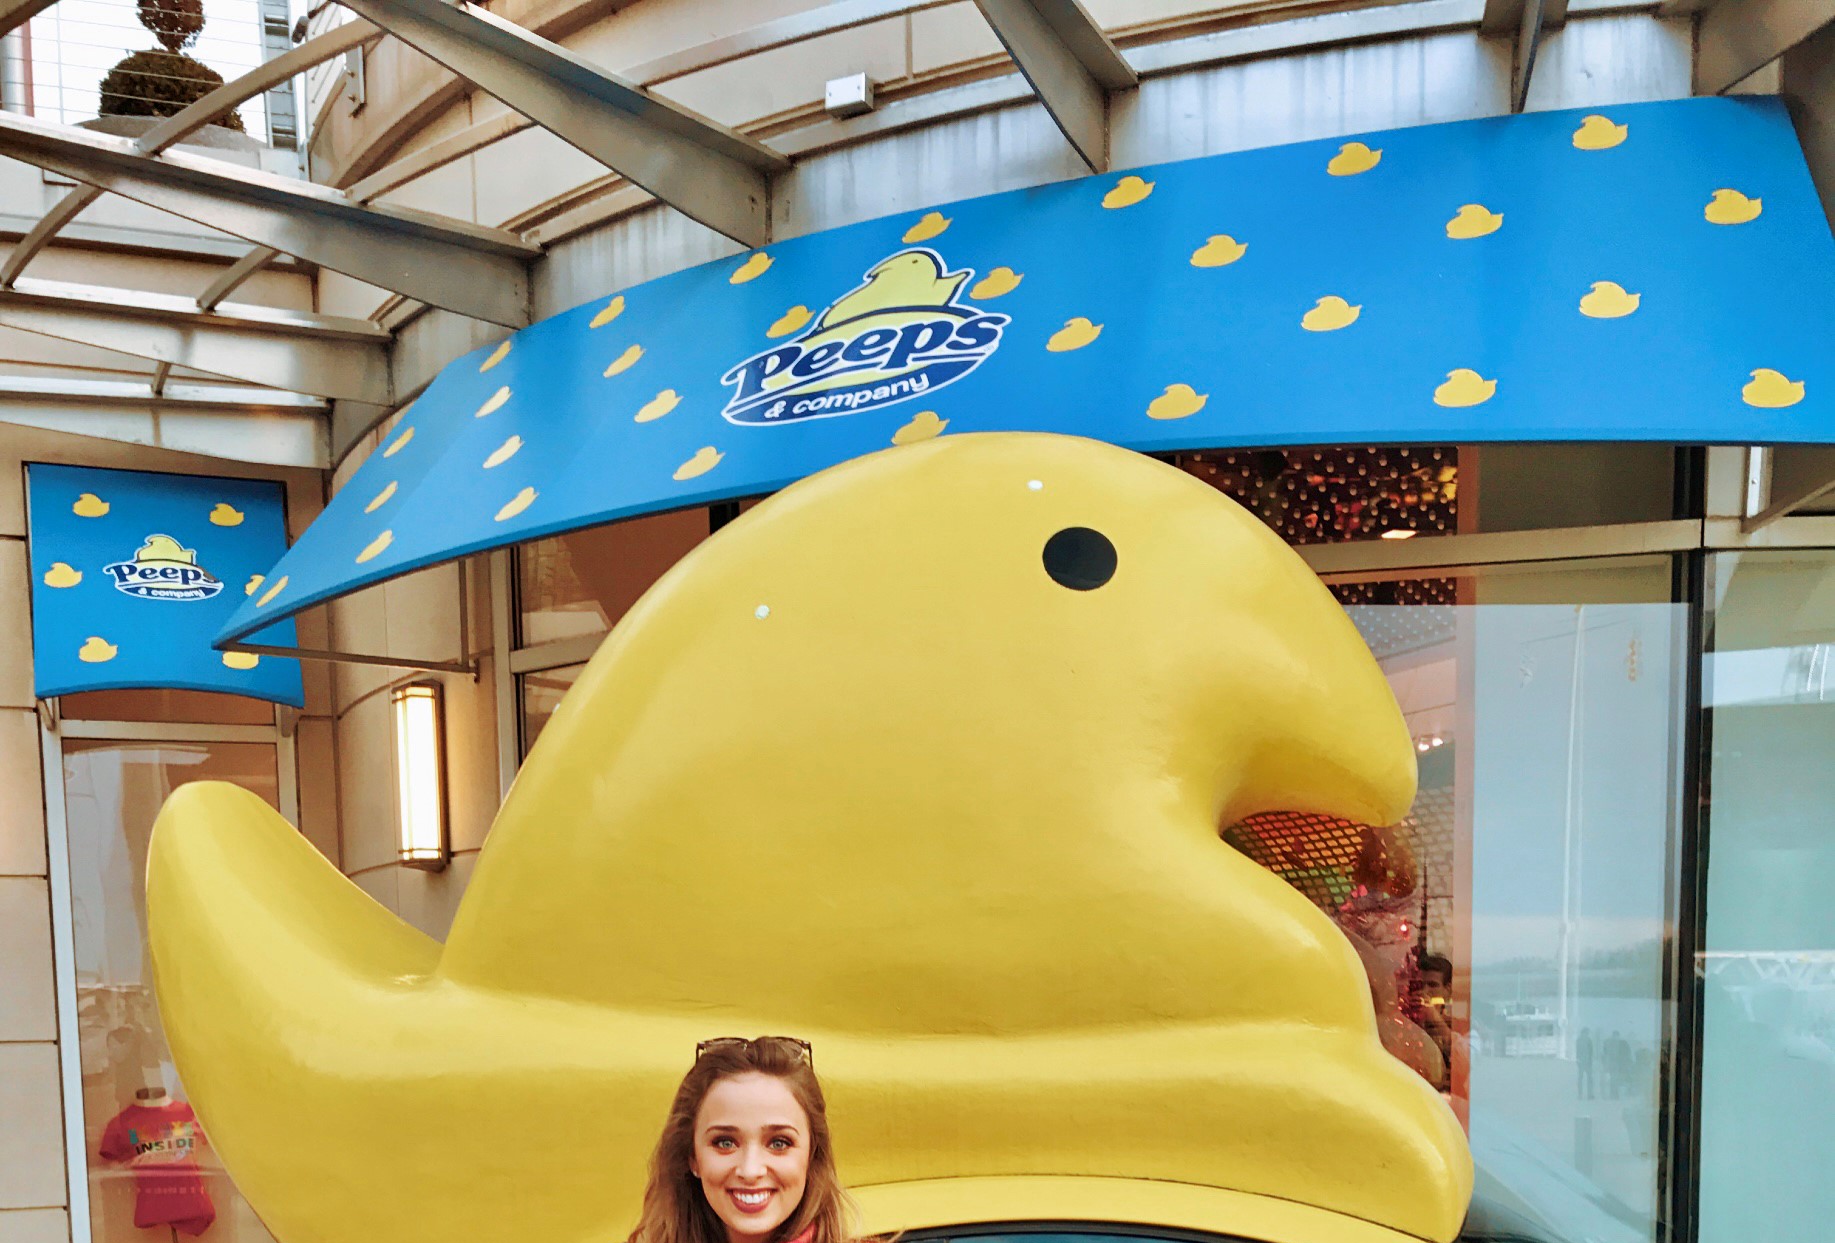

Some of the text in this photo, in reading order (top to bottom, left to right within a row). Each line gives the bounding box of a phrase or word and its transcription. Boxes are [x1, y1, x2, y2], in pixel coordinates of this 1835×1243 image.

[723, 314, 1010, 403] Peeps
[764, 372, 930, 419] & company
[105, 564, 220, 585] Peep
[151, 588, 206, 599] company
